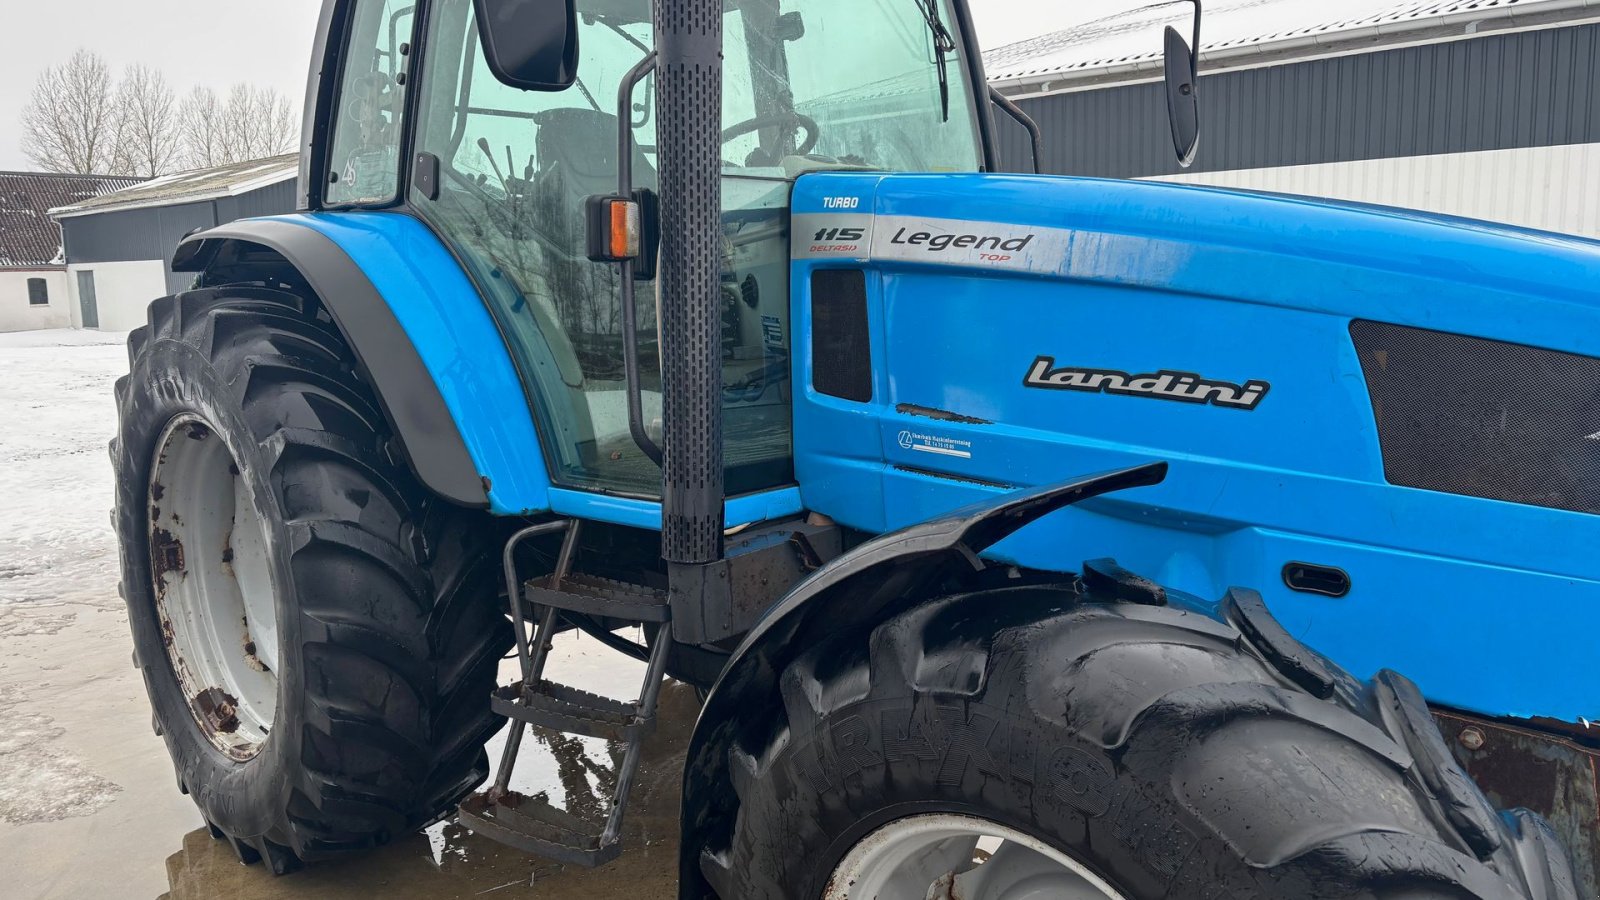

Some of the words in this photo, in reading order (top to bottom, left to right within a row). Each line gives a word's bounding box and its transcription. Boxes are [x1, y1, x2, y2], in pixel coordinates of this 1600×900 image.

[823, 196, 859, 208] TURBO
[814, 227, 866, 241] 115
[890, 227, 1035, 252] Legend
[979, 253, 1012, 263] TOP
[1024, 356, 1268, 409] Landini
